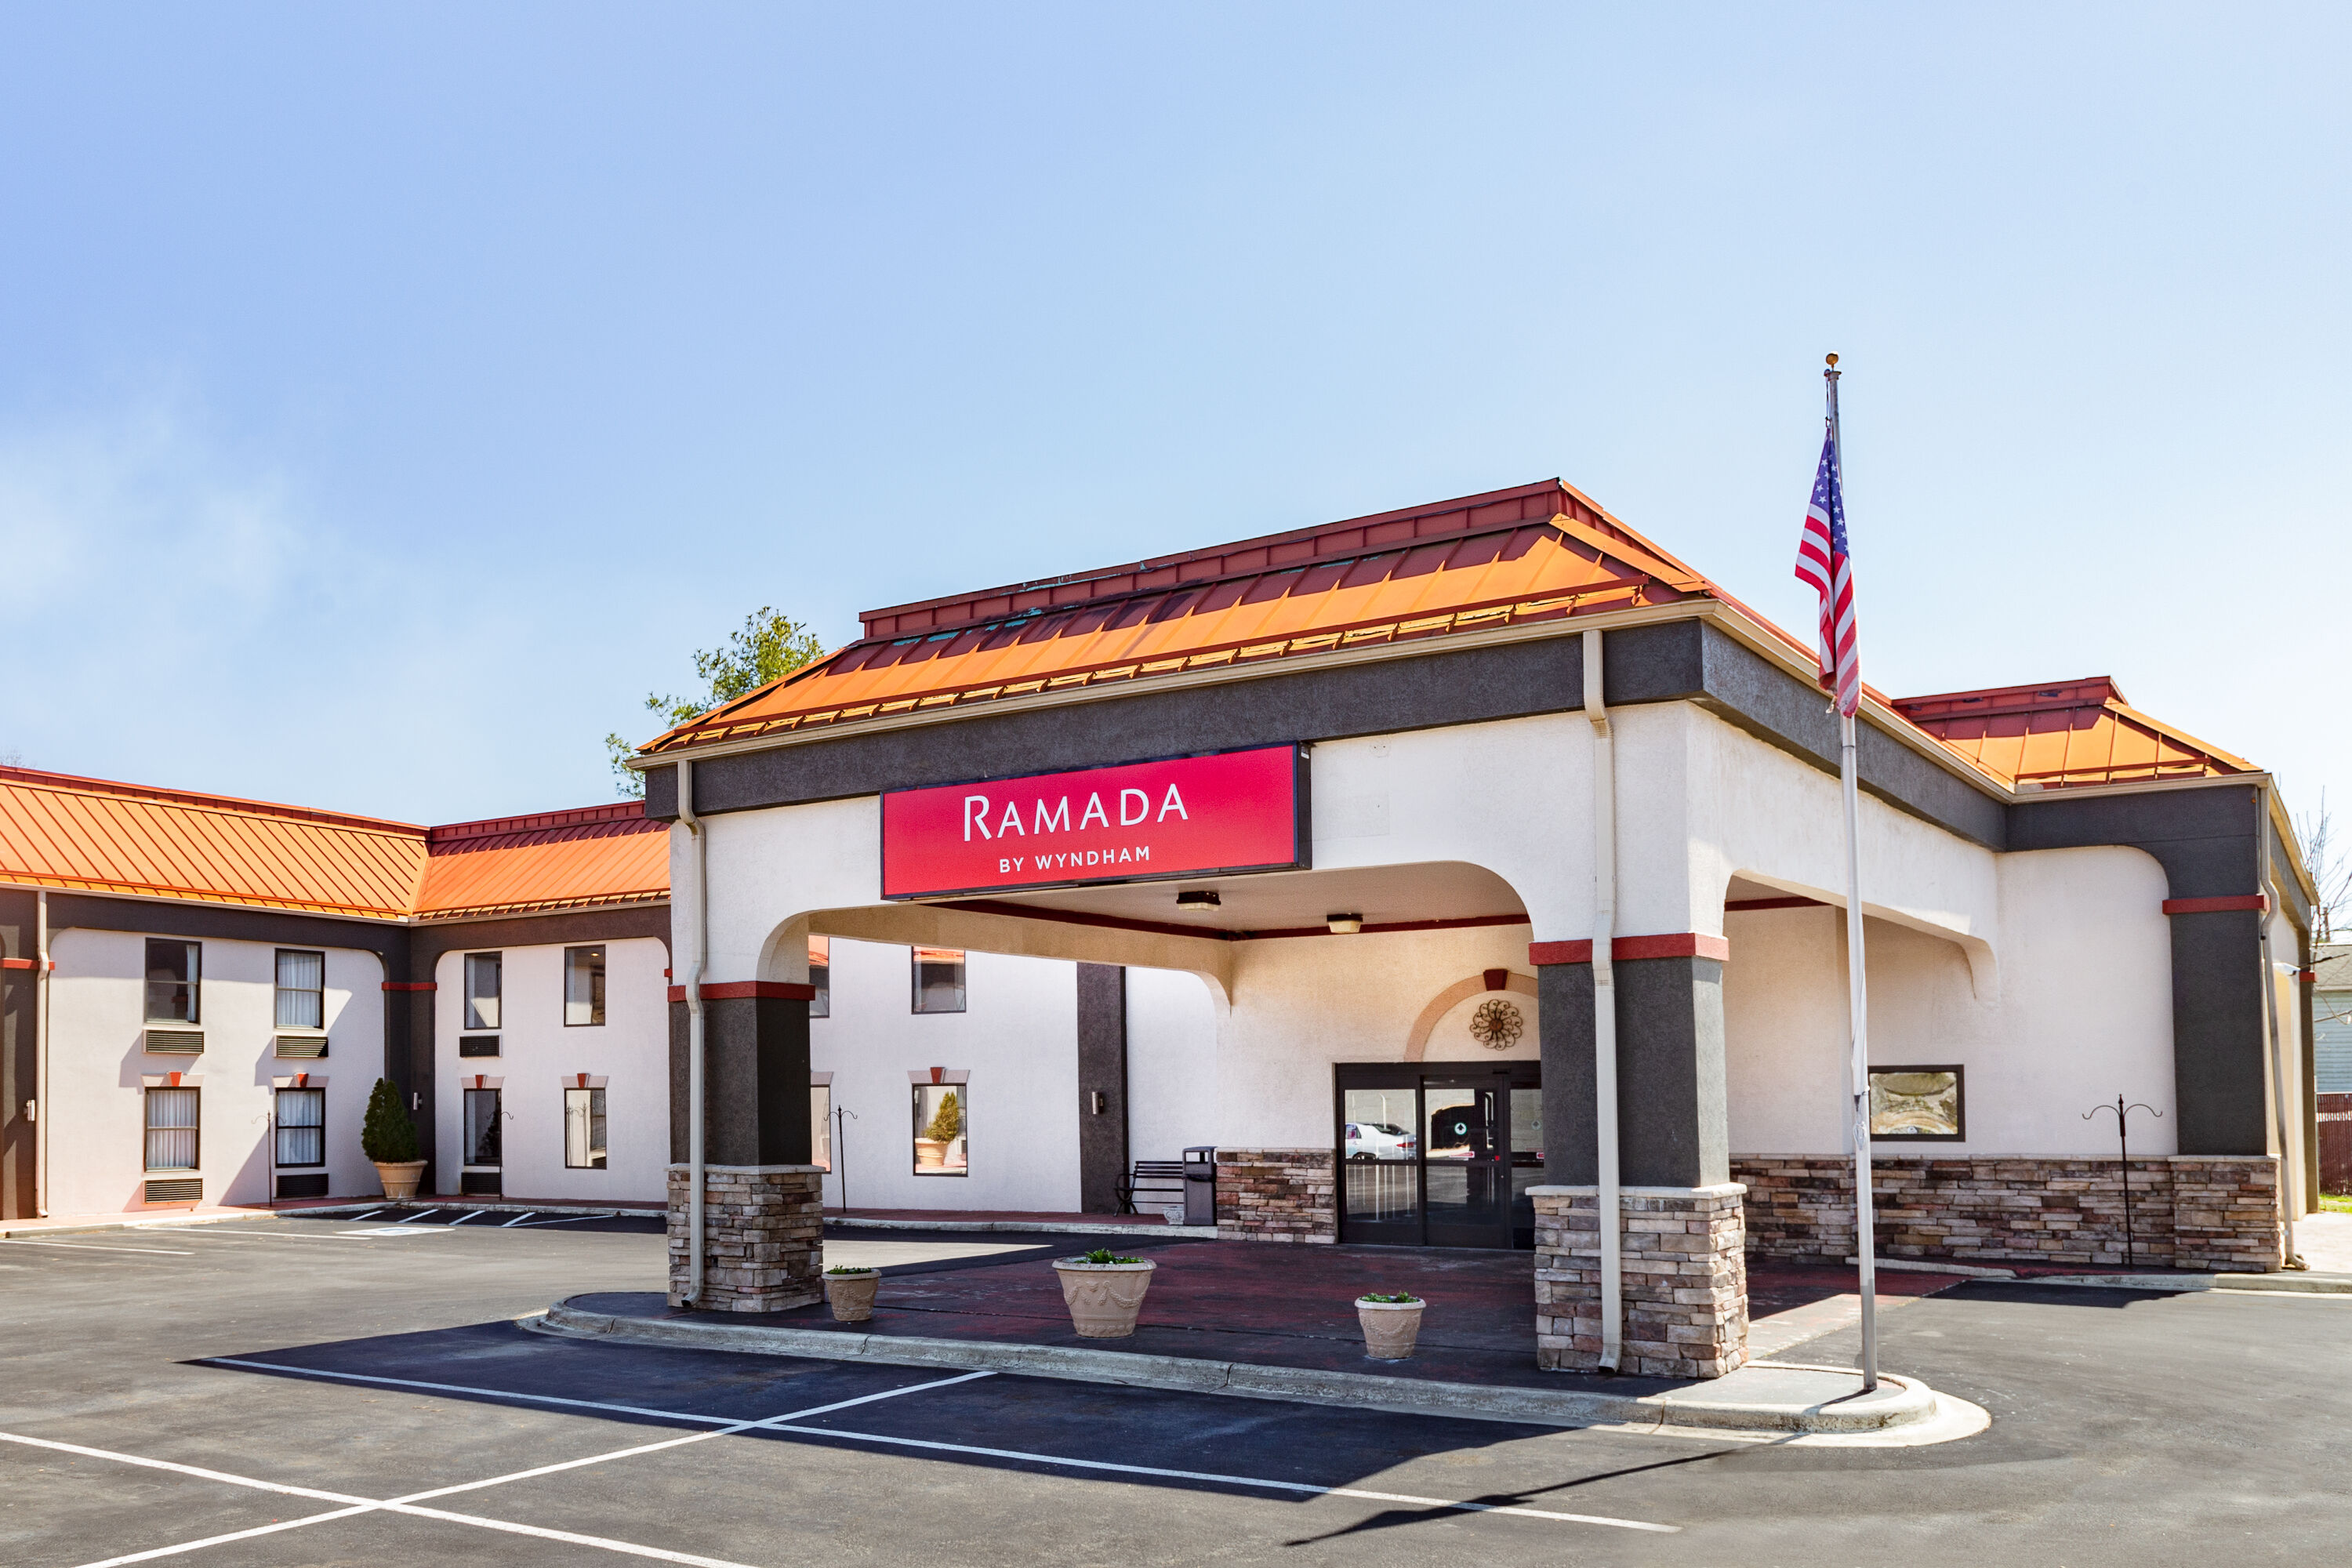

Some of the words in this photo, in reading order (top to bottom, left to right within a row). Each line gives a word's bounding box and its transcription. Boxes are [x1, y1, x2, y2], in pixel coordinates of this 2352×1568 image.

[964, 783, 1189, 842] RAMADA
[999, 857, 1024, 873] BY
[1034, 845, 1149, 870] WYNDHAM
